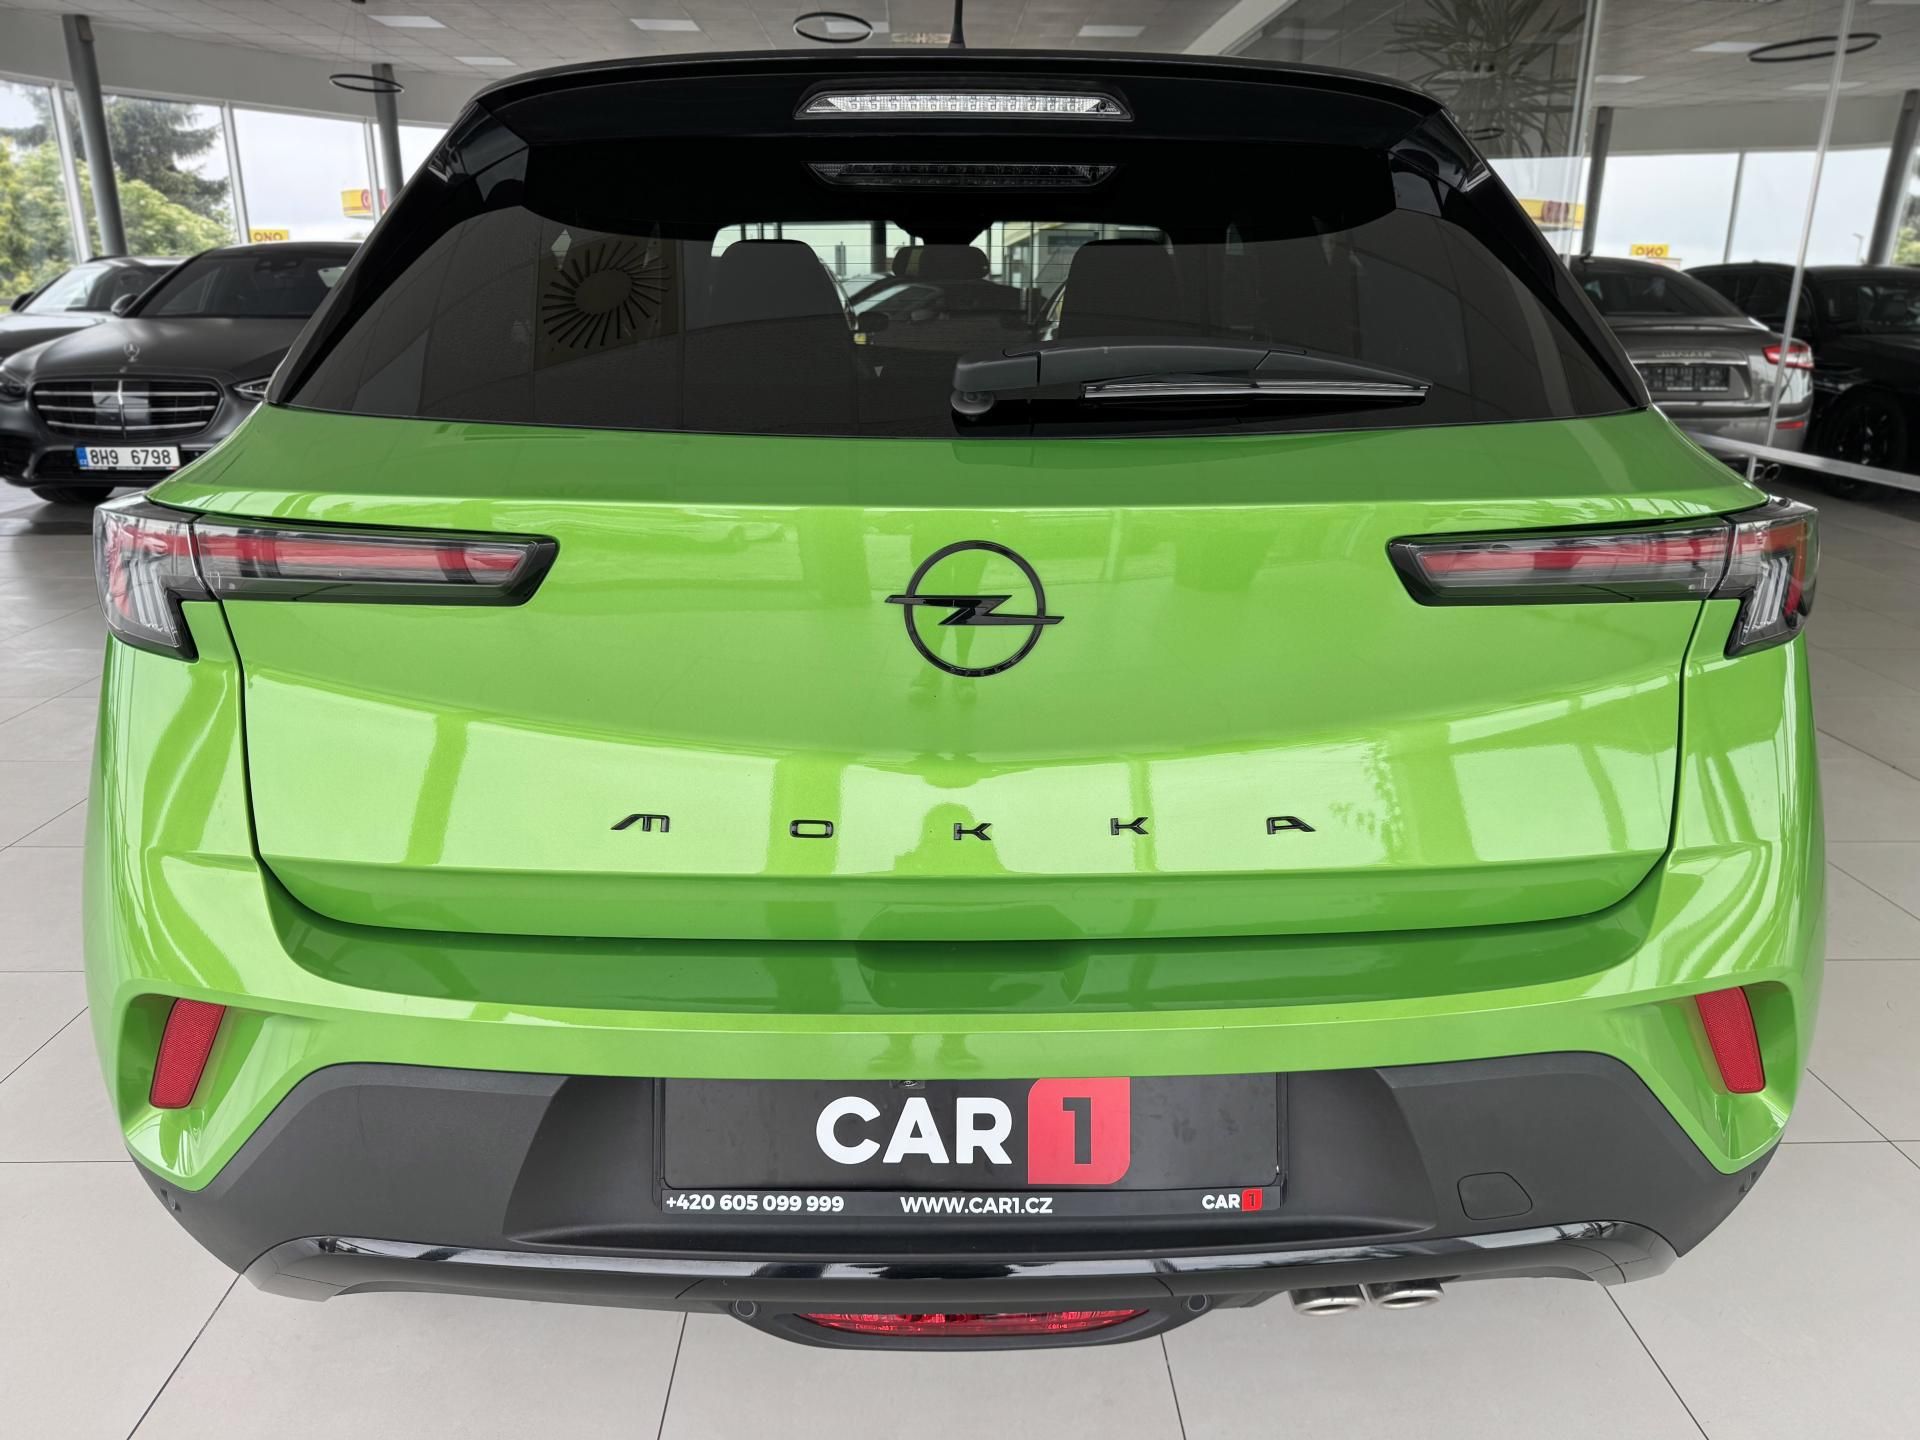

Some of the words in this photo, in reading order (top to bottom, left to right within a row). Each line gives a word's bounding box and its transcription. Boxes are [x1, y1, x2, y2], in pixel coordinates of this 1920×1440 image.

[90, 449, 119, 465] 8H9
[131, 449, 171, 465] 6798
[611, 813, 1316, 841] MOKKA
[666, 1193, 715, 1211] +420
[719, 1194, 759, 1211] 605
[762, 1195, 803, 1212] 099
[806, 1195, 845, 1213] 999
[900, 1196, 1053, 1214] WWW.CAR1.CZ
